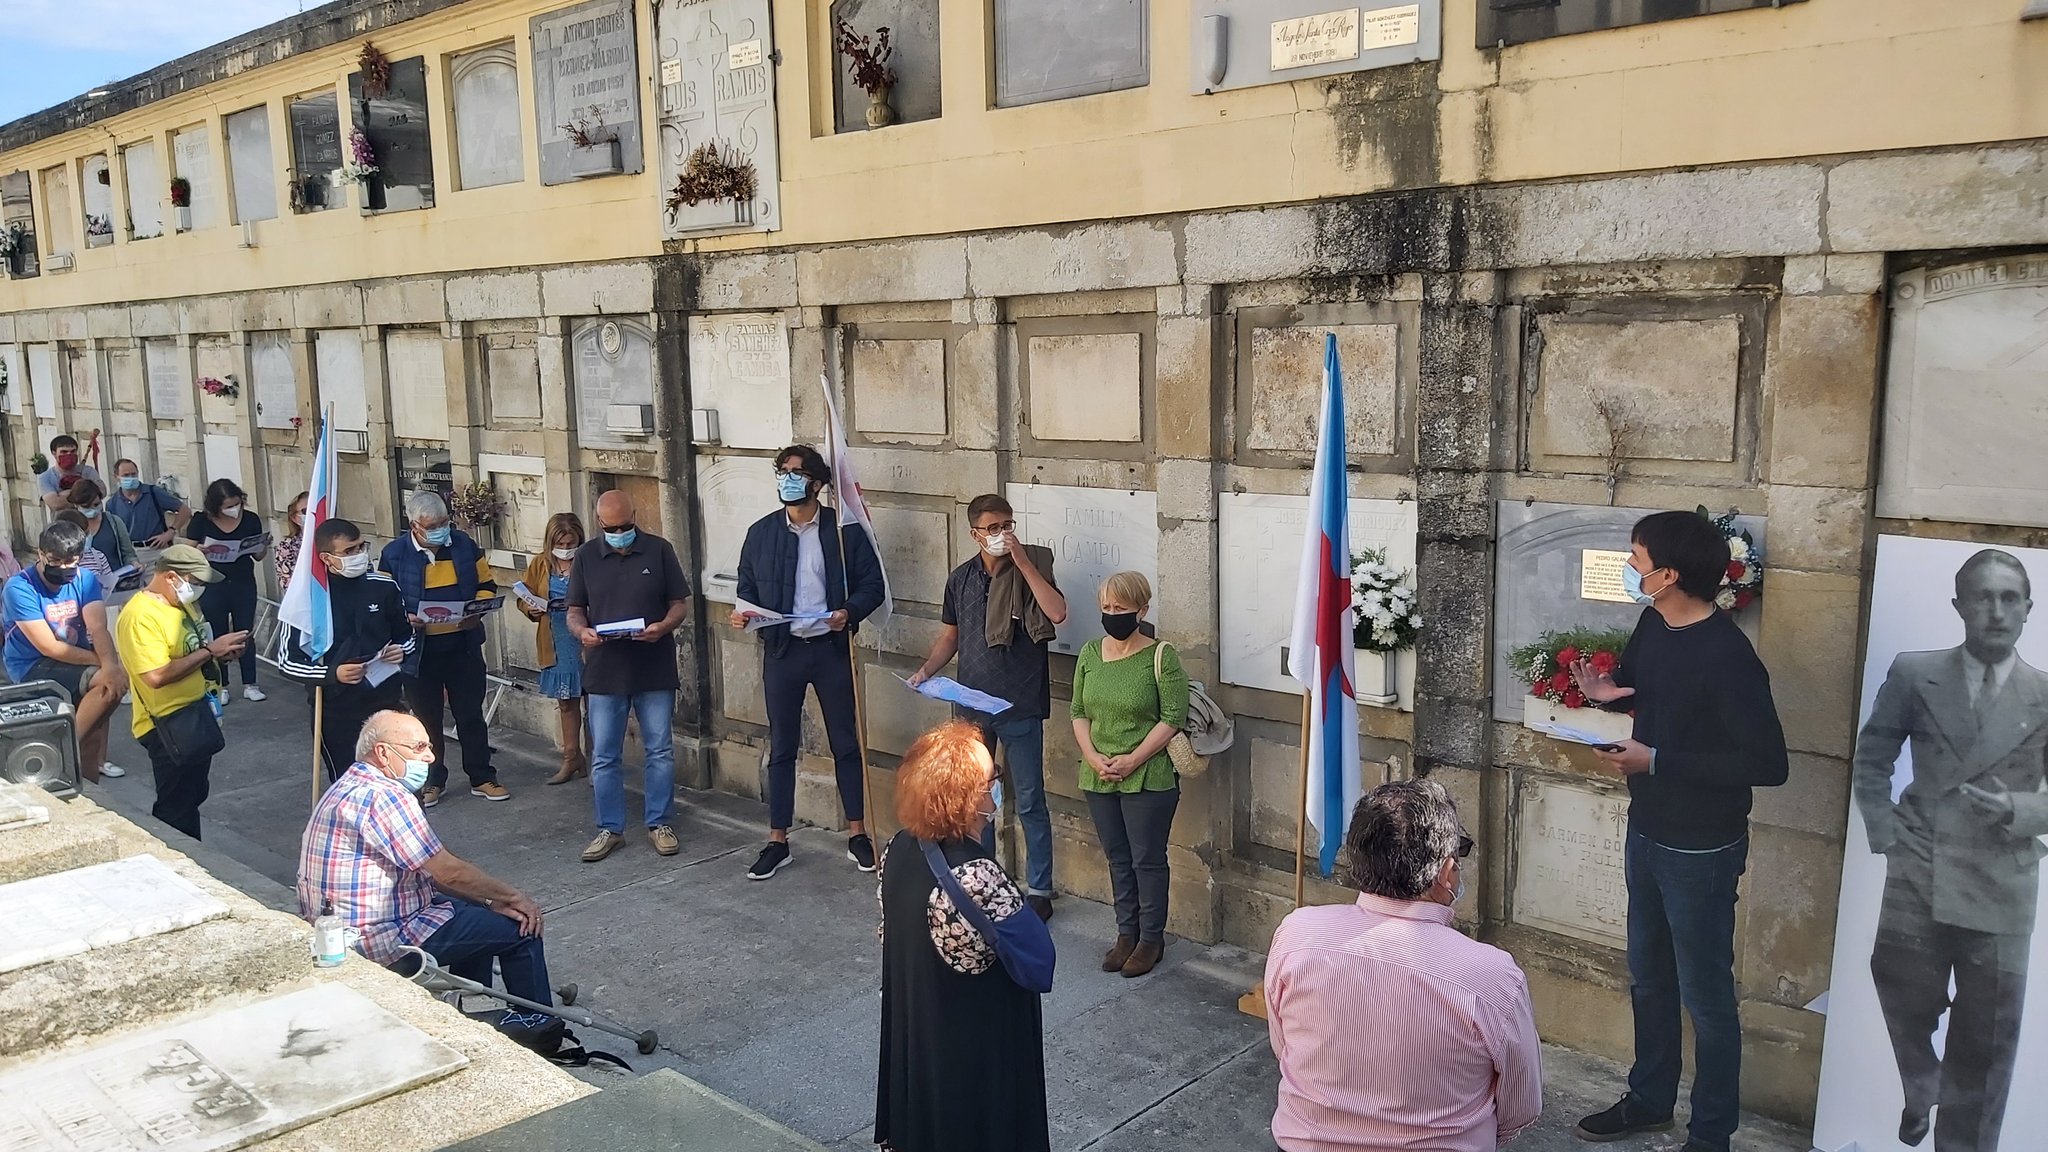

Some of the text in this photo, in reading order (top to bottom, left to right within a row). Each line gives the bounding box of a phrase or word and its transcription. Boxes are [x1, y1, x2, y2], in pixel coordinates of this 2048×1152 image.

[664, 80, 697, 113] LUIS
[717, 66, 766, 101] RAMOS
[1930, 263, 2009, 294] DOMINGO
[736, 323, 776, 335] FAMILIAS
[1065, 507, 1126, 528] FAMILIA
[1350, 513, 1408, 531] ODRIGUEZ
[1062, 535, 1121, 567] CAMPO
[1538, 824, 1596, 847] CARMEN
